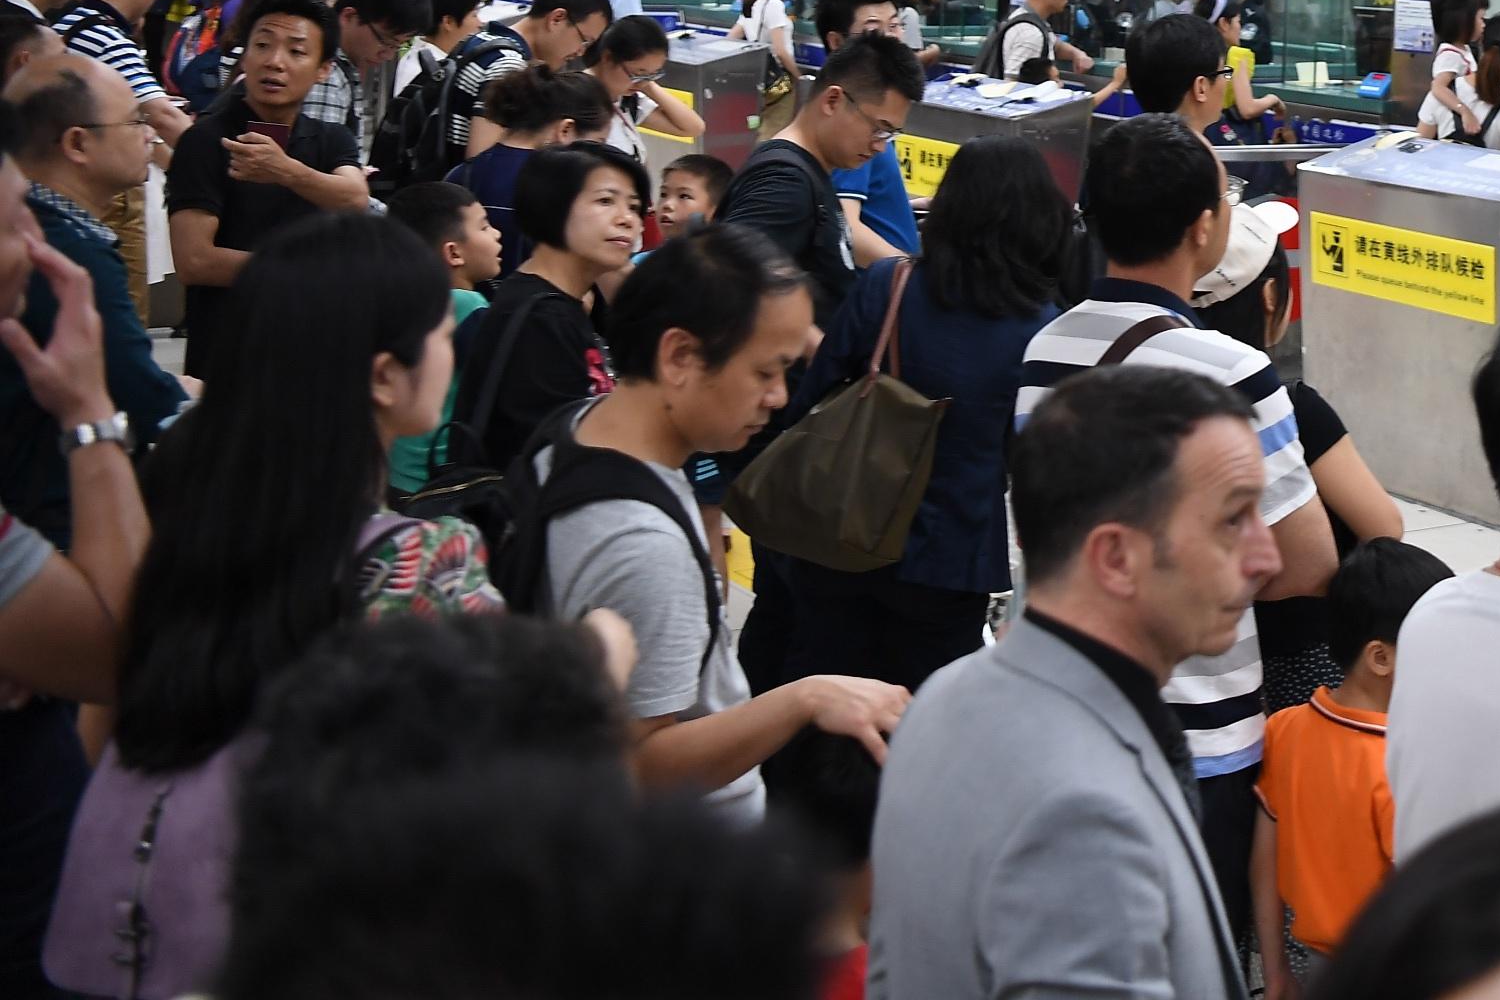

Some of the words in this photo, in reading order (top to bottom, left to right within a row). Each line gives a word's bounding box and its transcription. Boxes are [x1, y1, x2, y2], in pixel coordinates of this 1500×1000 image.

[1355, 235, 1485, 279] 请在黄线外排队候检
